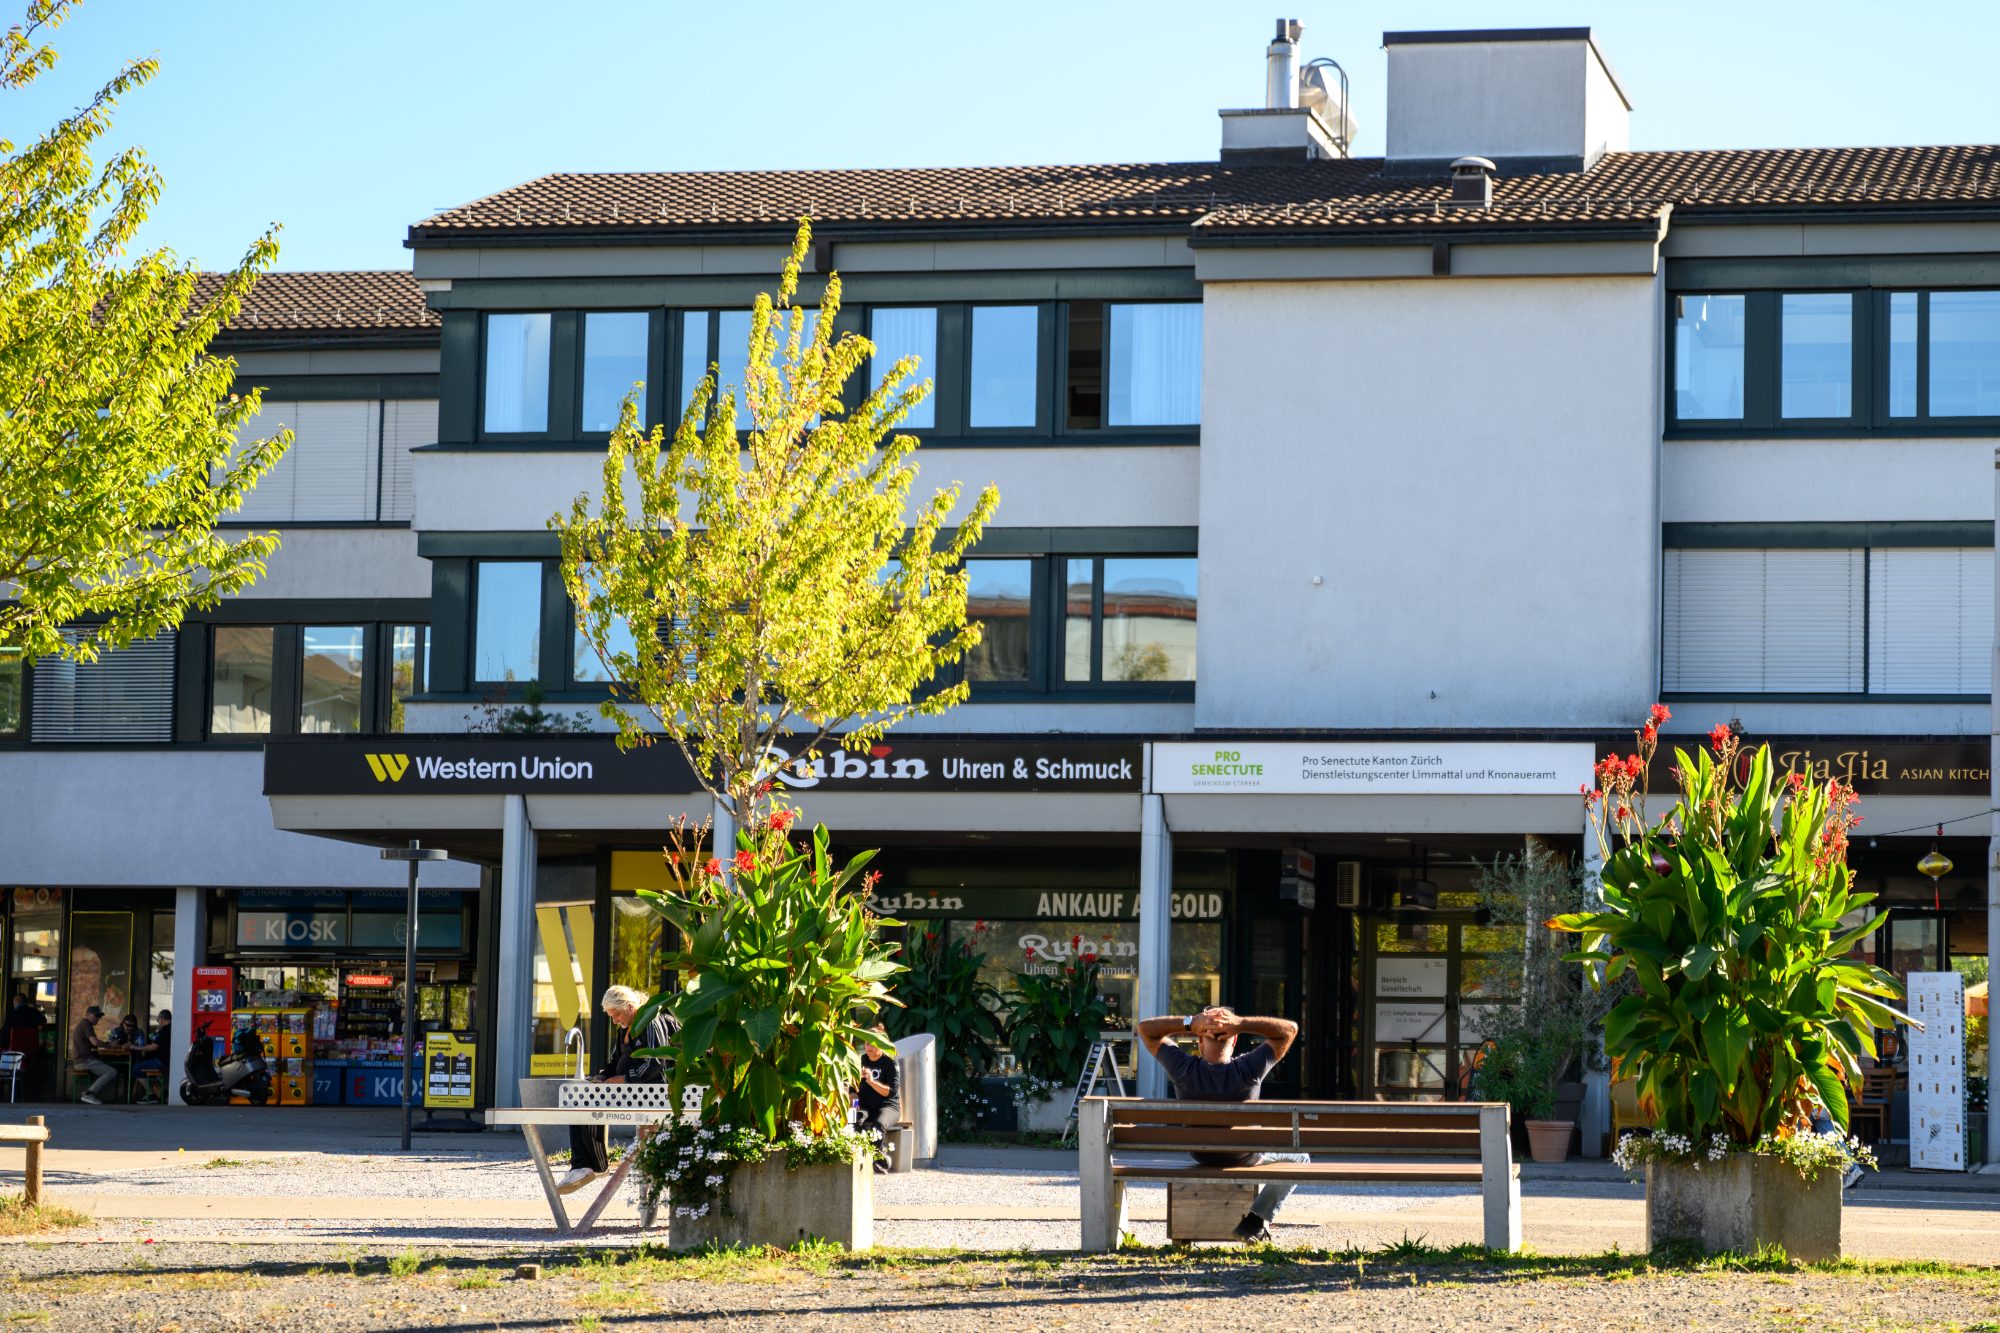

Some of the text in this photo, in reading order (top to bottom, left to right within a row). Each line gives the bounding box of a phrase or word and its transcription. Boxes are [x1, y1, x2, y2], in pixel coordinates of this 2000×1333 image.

[1215, 751, 1241, 762] PRO
[1302, 755, 1443, 766] Pro Senectute Kanton Zürich
[415, 756, 593, 779] Western Union
[739, 746, 929, 788] Rubin
[942, 757, 1132, 780] Uhren & Schmuck
[1191, 764, 1263, 775] SENECTUTE
[1302, 769, 1557, 782] Dienstleistungscenter Limmattal und Knonaueramt
[1900, 768, 1990, 780] ASIAN KITCH
[849, 889, 964, 915] Rubin
[1037, 893, 1123, 917] ANKAUF
[264, 920, 338, 941] KIOSK
[1018, 934, 1138, 962] Rubin
[1024, 963, 1058, 975] Uhren
[203, 994, 223, 1005] 120
[316, 1080, 331, 1093] 77
[606, 1113, 632, 1121] PINGO
